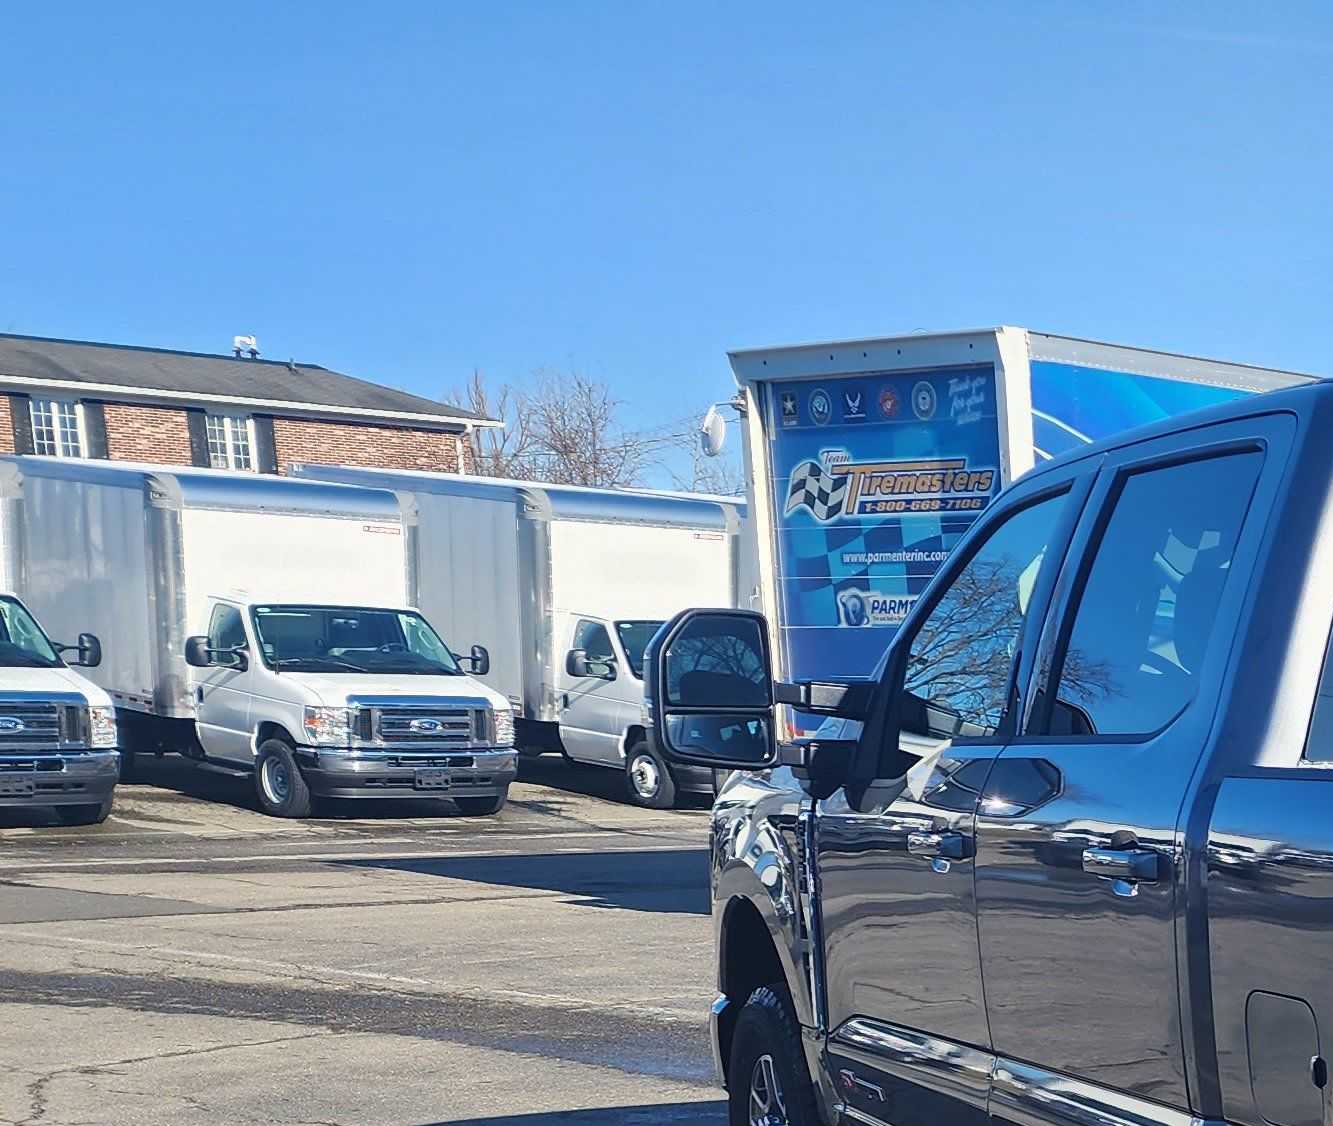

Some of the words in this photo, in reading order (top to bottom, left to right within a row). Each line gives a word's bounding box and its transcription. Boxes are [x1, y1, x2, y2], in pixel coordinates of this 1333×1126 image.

[822, 450, 850, 464] Team
[831, 459, 993, 514] Tiremasters
[864, 499, 981, 511] 1-800-669-7106
[843, 549, 951, 566] www.parmenterinc.com
